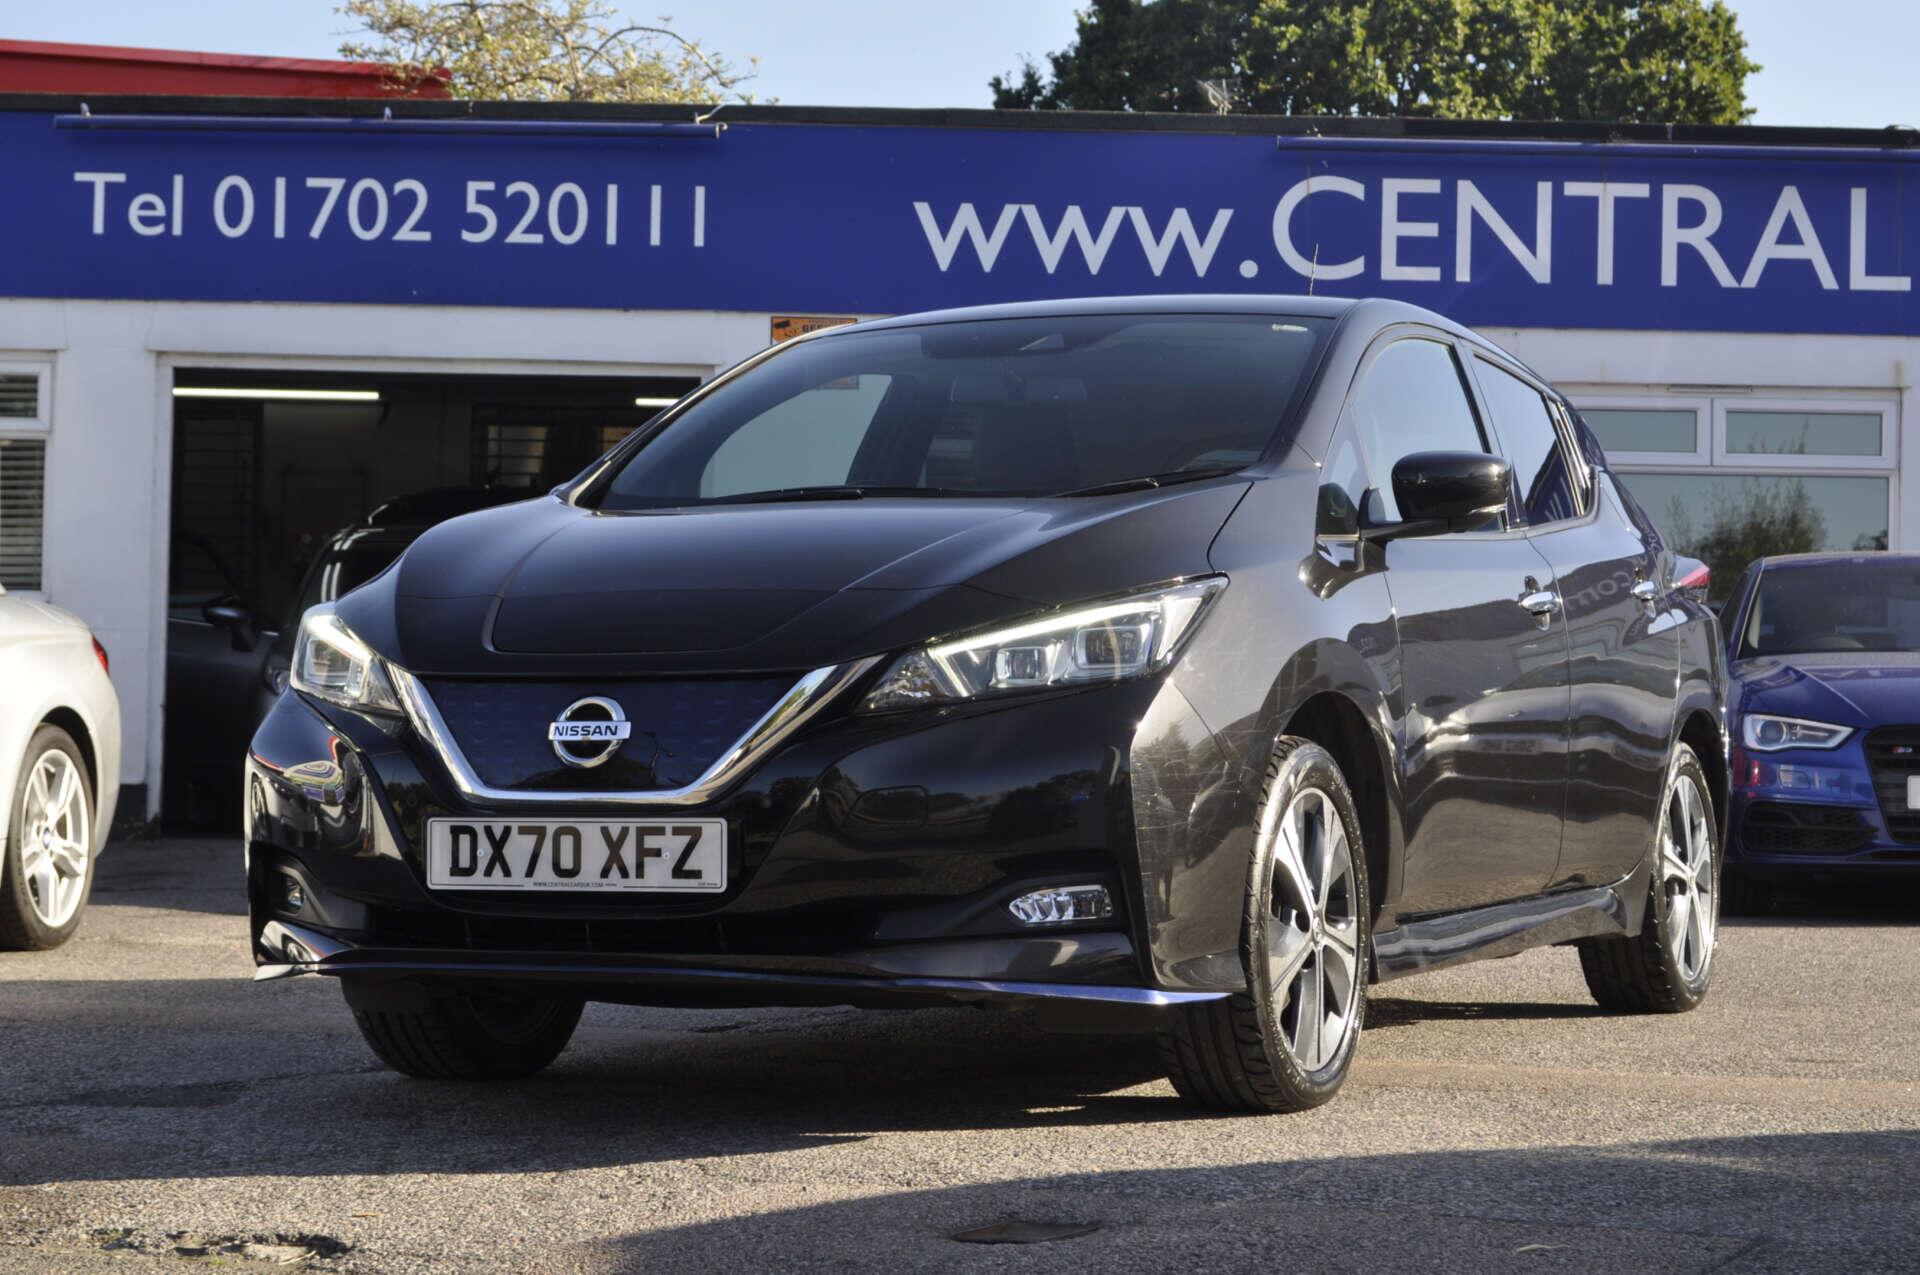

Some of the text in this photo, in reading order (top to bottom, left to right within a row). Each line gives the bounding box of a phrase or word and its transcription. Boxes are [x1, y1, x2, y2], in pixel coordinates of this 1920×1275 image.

[73, 172, 706, 247] Tel 01702 520111
[554, 725, 618, 736] NISSAN
[449, 824, 703, 880] DX70 XFZ
